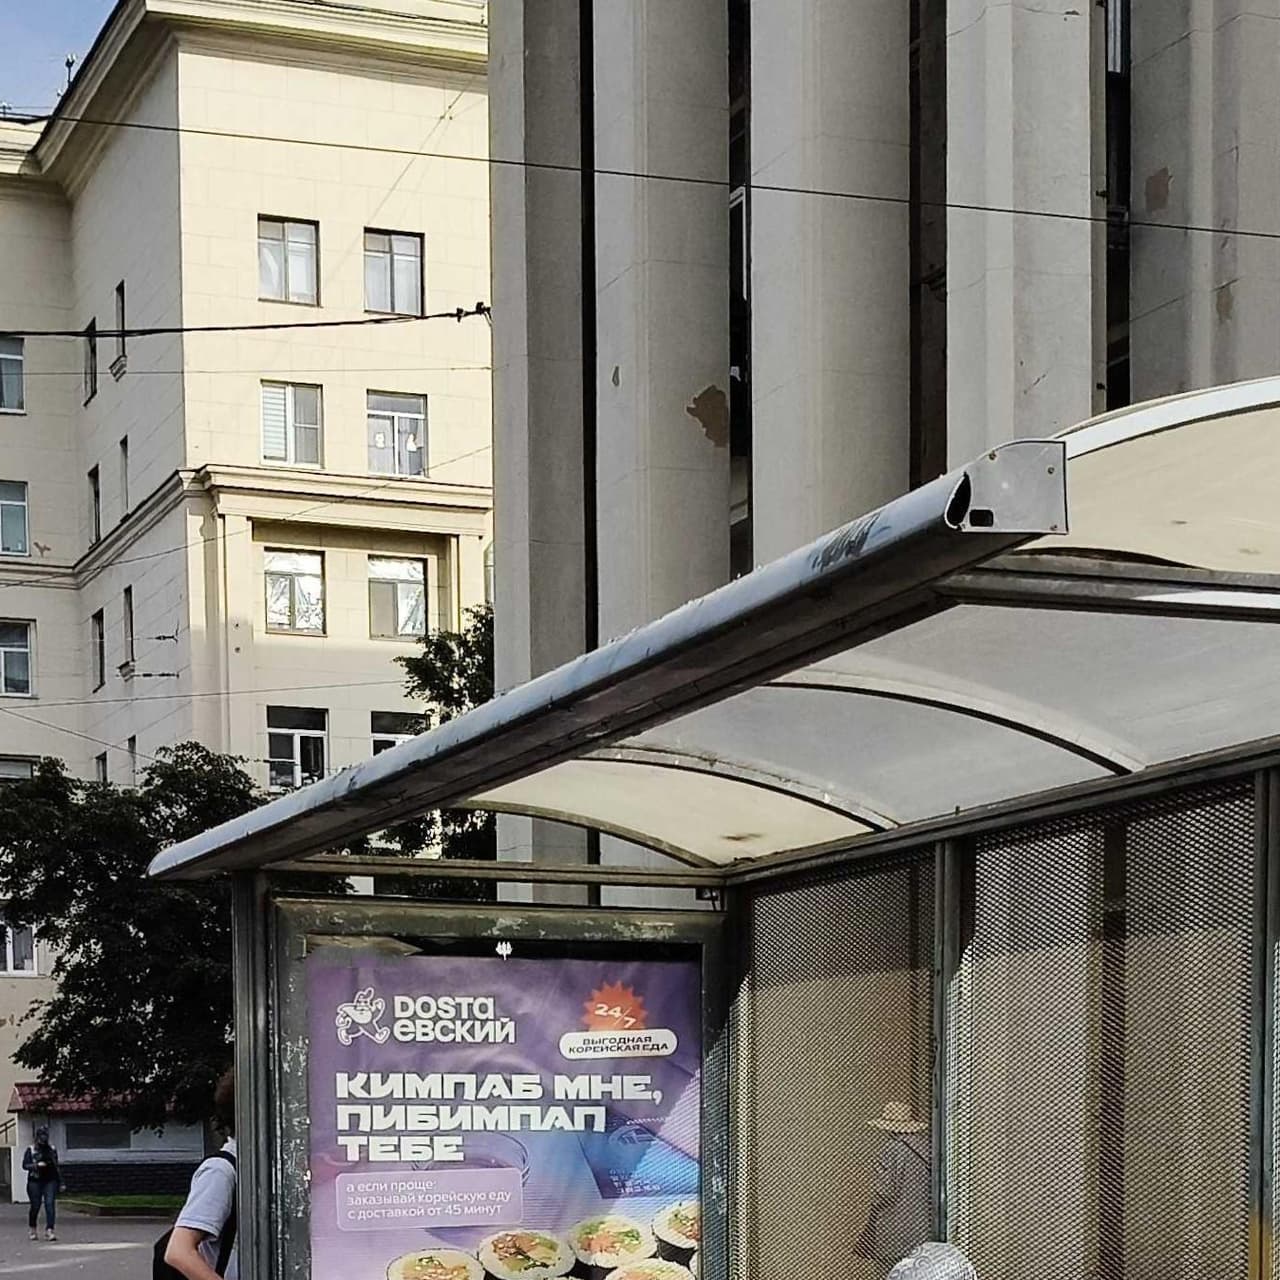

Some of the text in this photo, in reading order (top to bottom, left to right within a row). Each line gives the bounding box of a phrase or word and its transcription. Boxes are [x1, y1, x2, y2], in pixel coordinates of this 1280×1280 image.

[593, 1003, 637, 1029] 24/7
[568, 1043, 670, 1054] КОРЕЙСКАЯ ЕДА
[582, 1036, 653, 1046] ВЫГОДНАЯ
[335, 1072, 663, 1105] КИМПАБ МНЕ,
[336, 1105, 607, 1133] ПИБИМПАП
[336, 1135, 465, 1162] ТЕБЕ
[346, 1182, 355, 1193] а
[357, 1181, 388, 1193] если
[346, 1190, 512, 1206] заказывай корейскую еду
[347, 1203, 503, 1221] с доставкой от 45 минут
